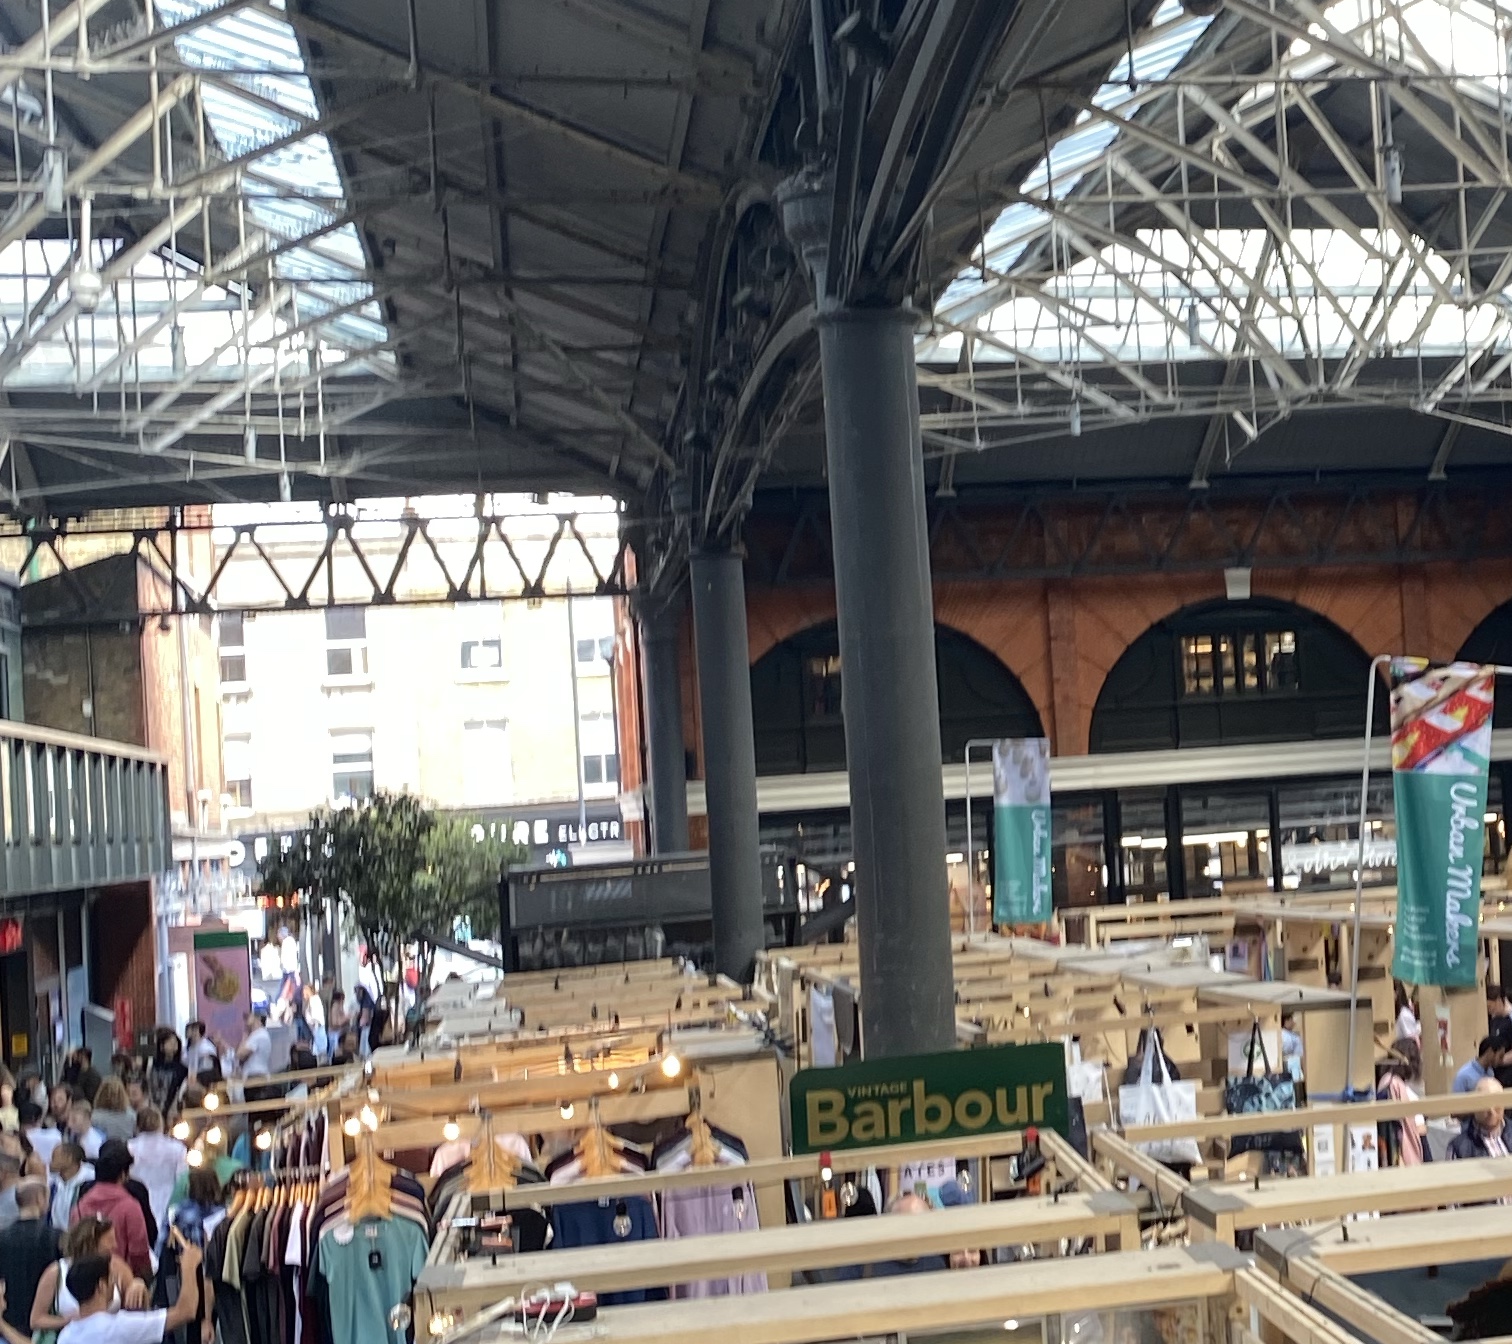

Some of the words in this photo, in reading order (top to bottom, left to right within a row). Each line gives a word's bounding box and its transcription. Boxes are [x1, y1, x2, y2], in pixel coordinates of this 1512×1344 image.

[1449, 781, 1479, 863] Urban
[1446, 864, 1474, 968] Makers
[806, 1078, 1054, 1147] Barbour
[847, 1082, 909, 1099] VINTAGE
